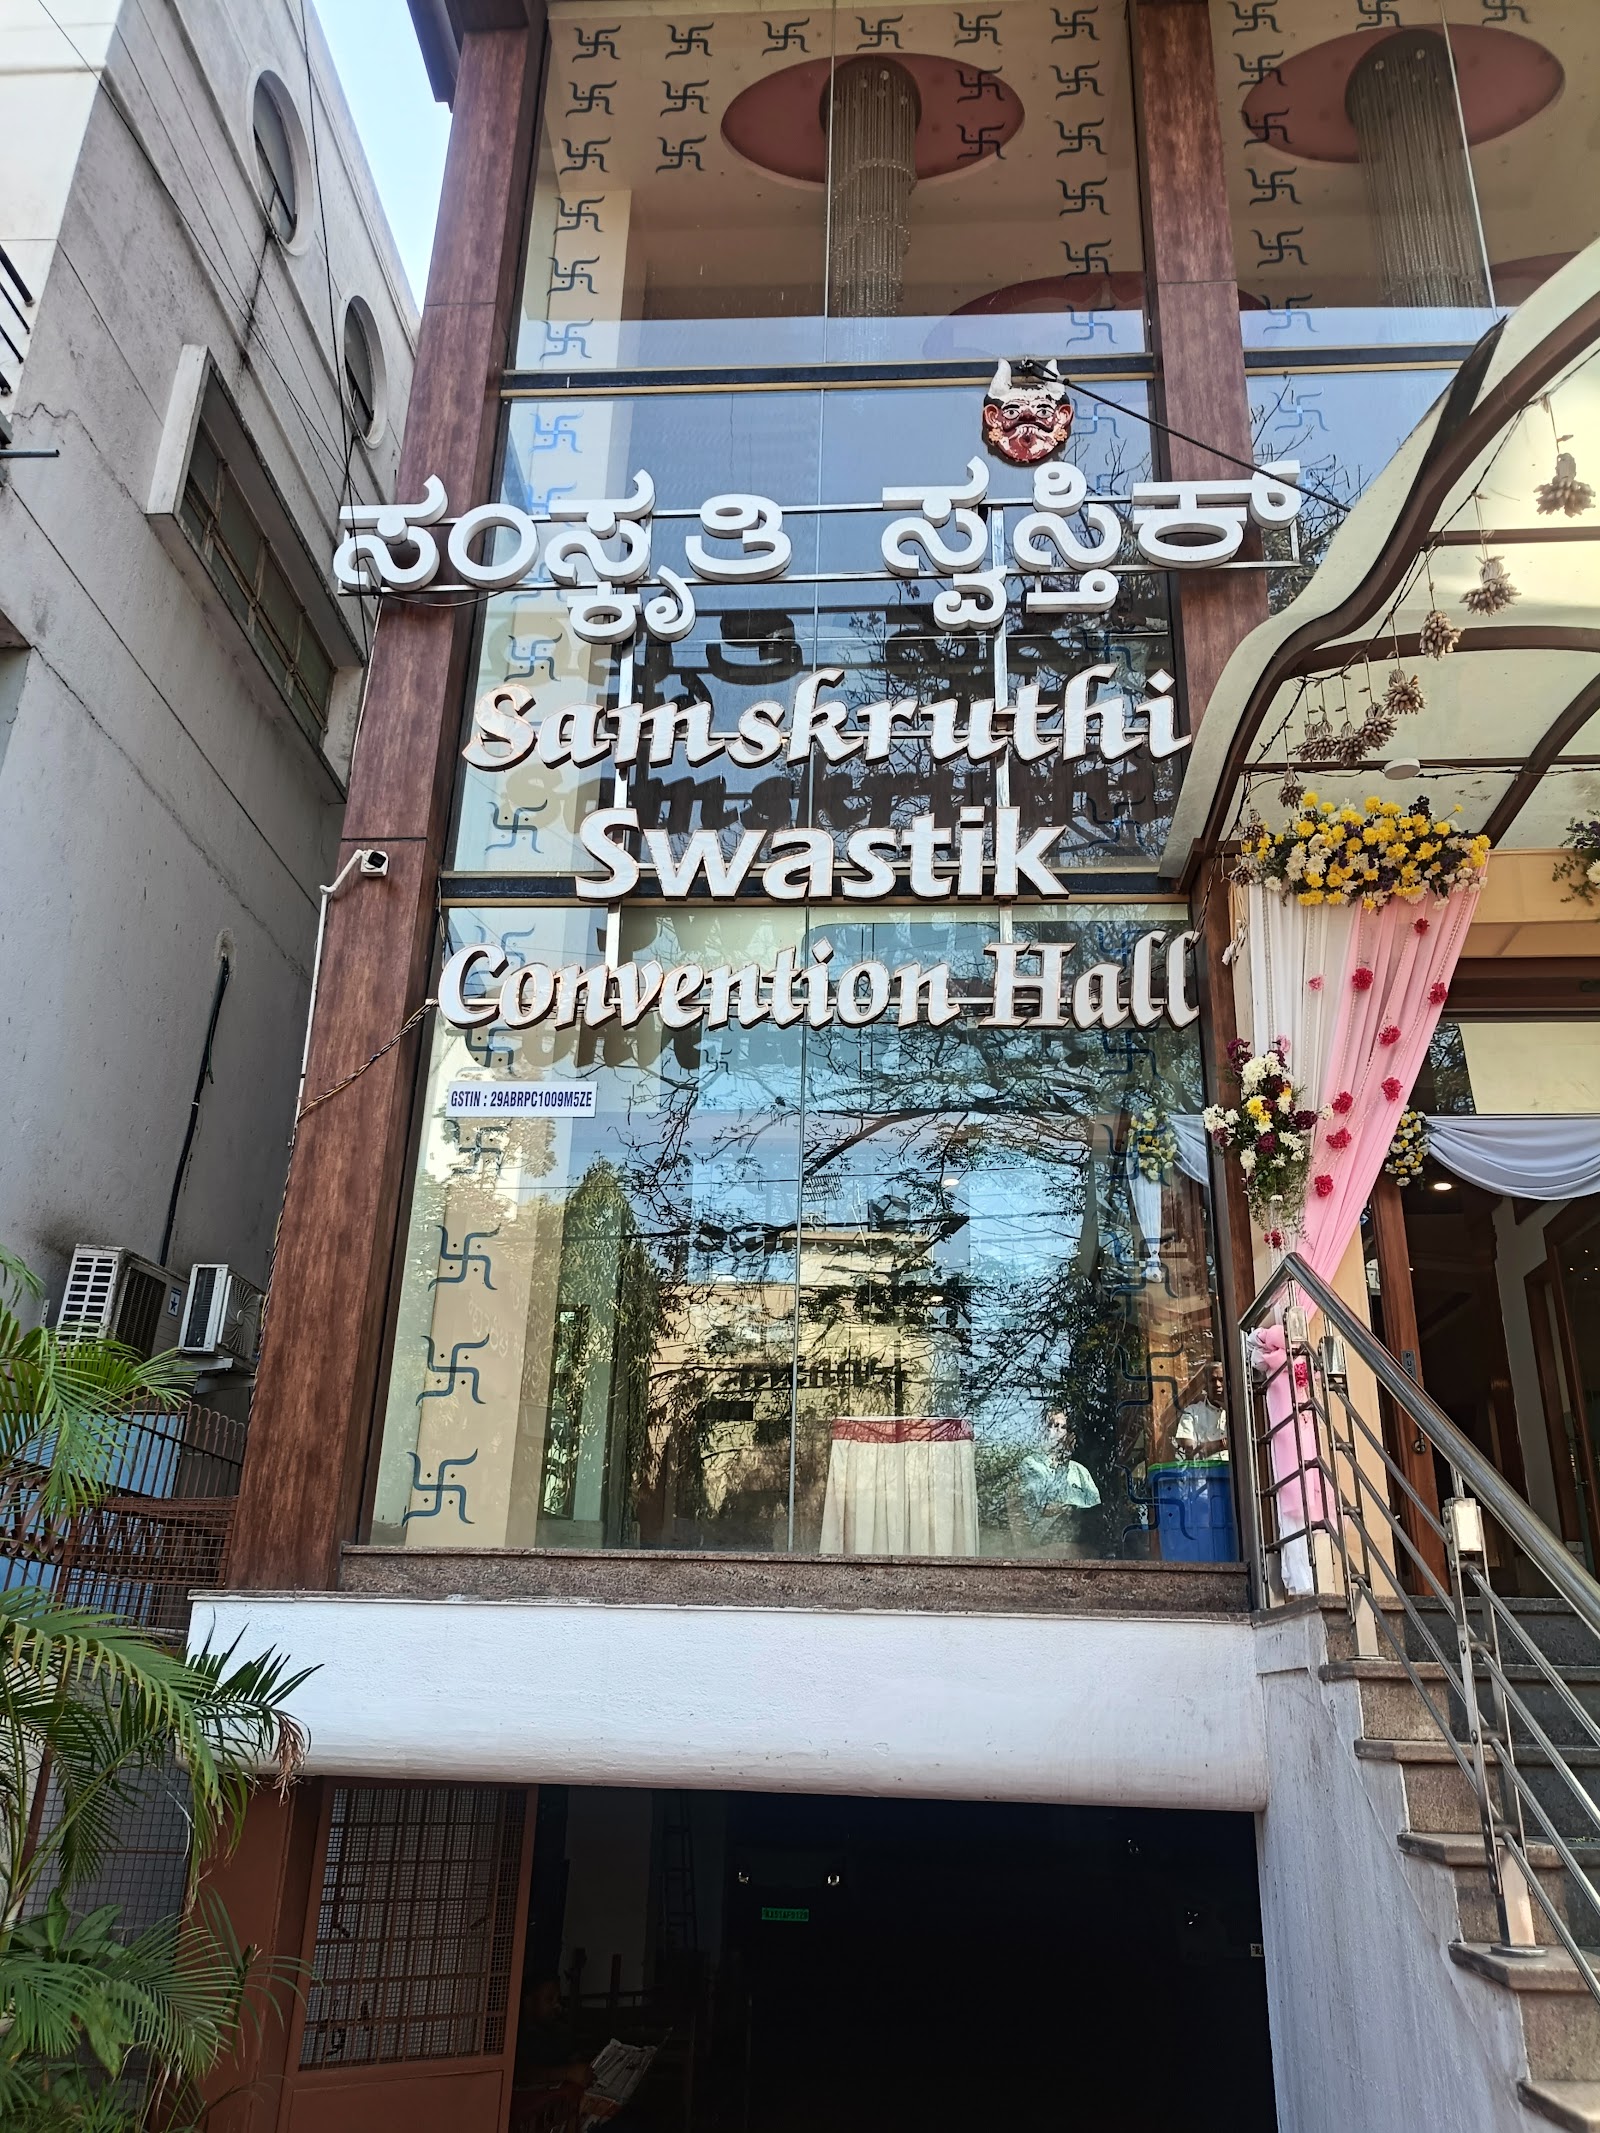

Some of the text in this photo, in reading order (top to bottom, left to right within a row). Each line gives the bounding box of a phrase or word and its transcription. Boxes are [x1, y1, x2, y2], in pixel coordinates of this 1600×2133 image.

[333, 456, 1301, 645] ಸಂಸ್ಕೃತಿ ಸ್ವಸ್ತಿಕ್
[461, 664, 1193, 771] Samskruthi
[573, 806, 1069, 902] Swastik
[437, 929, 1200, 1031] Convention Hall
[451, 1090, 481, 1107] GSTIN
[490, 1091, 592, 1107] 29ABRPC1009M5ZE
